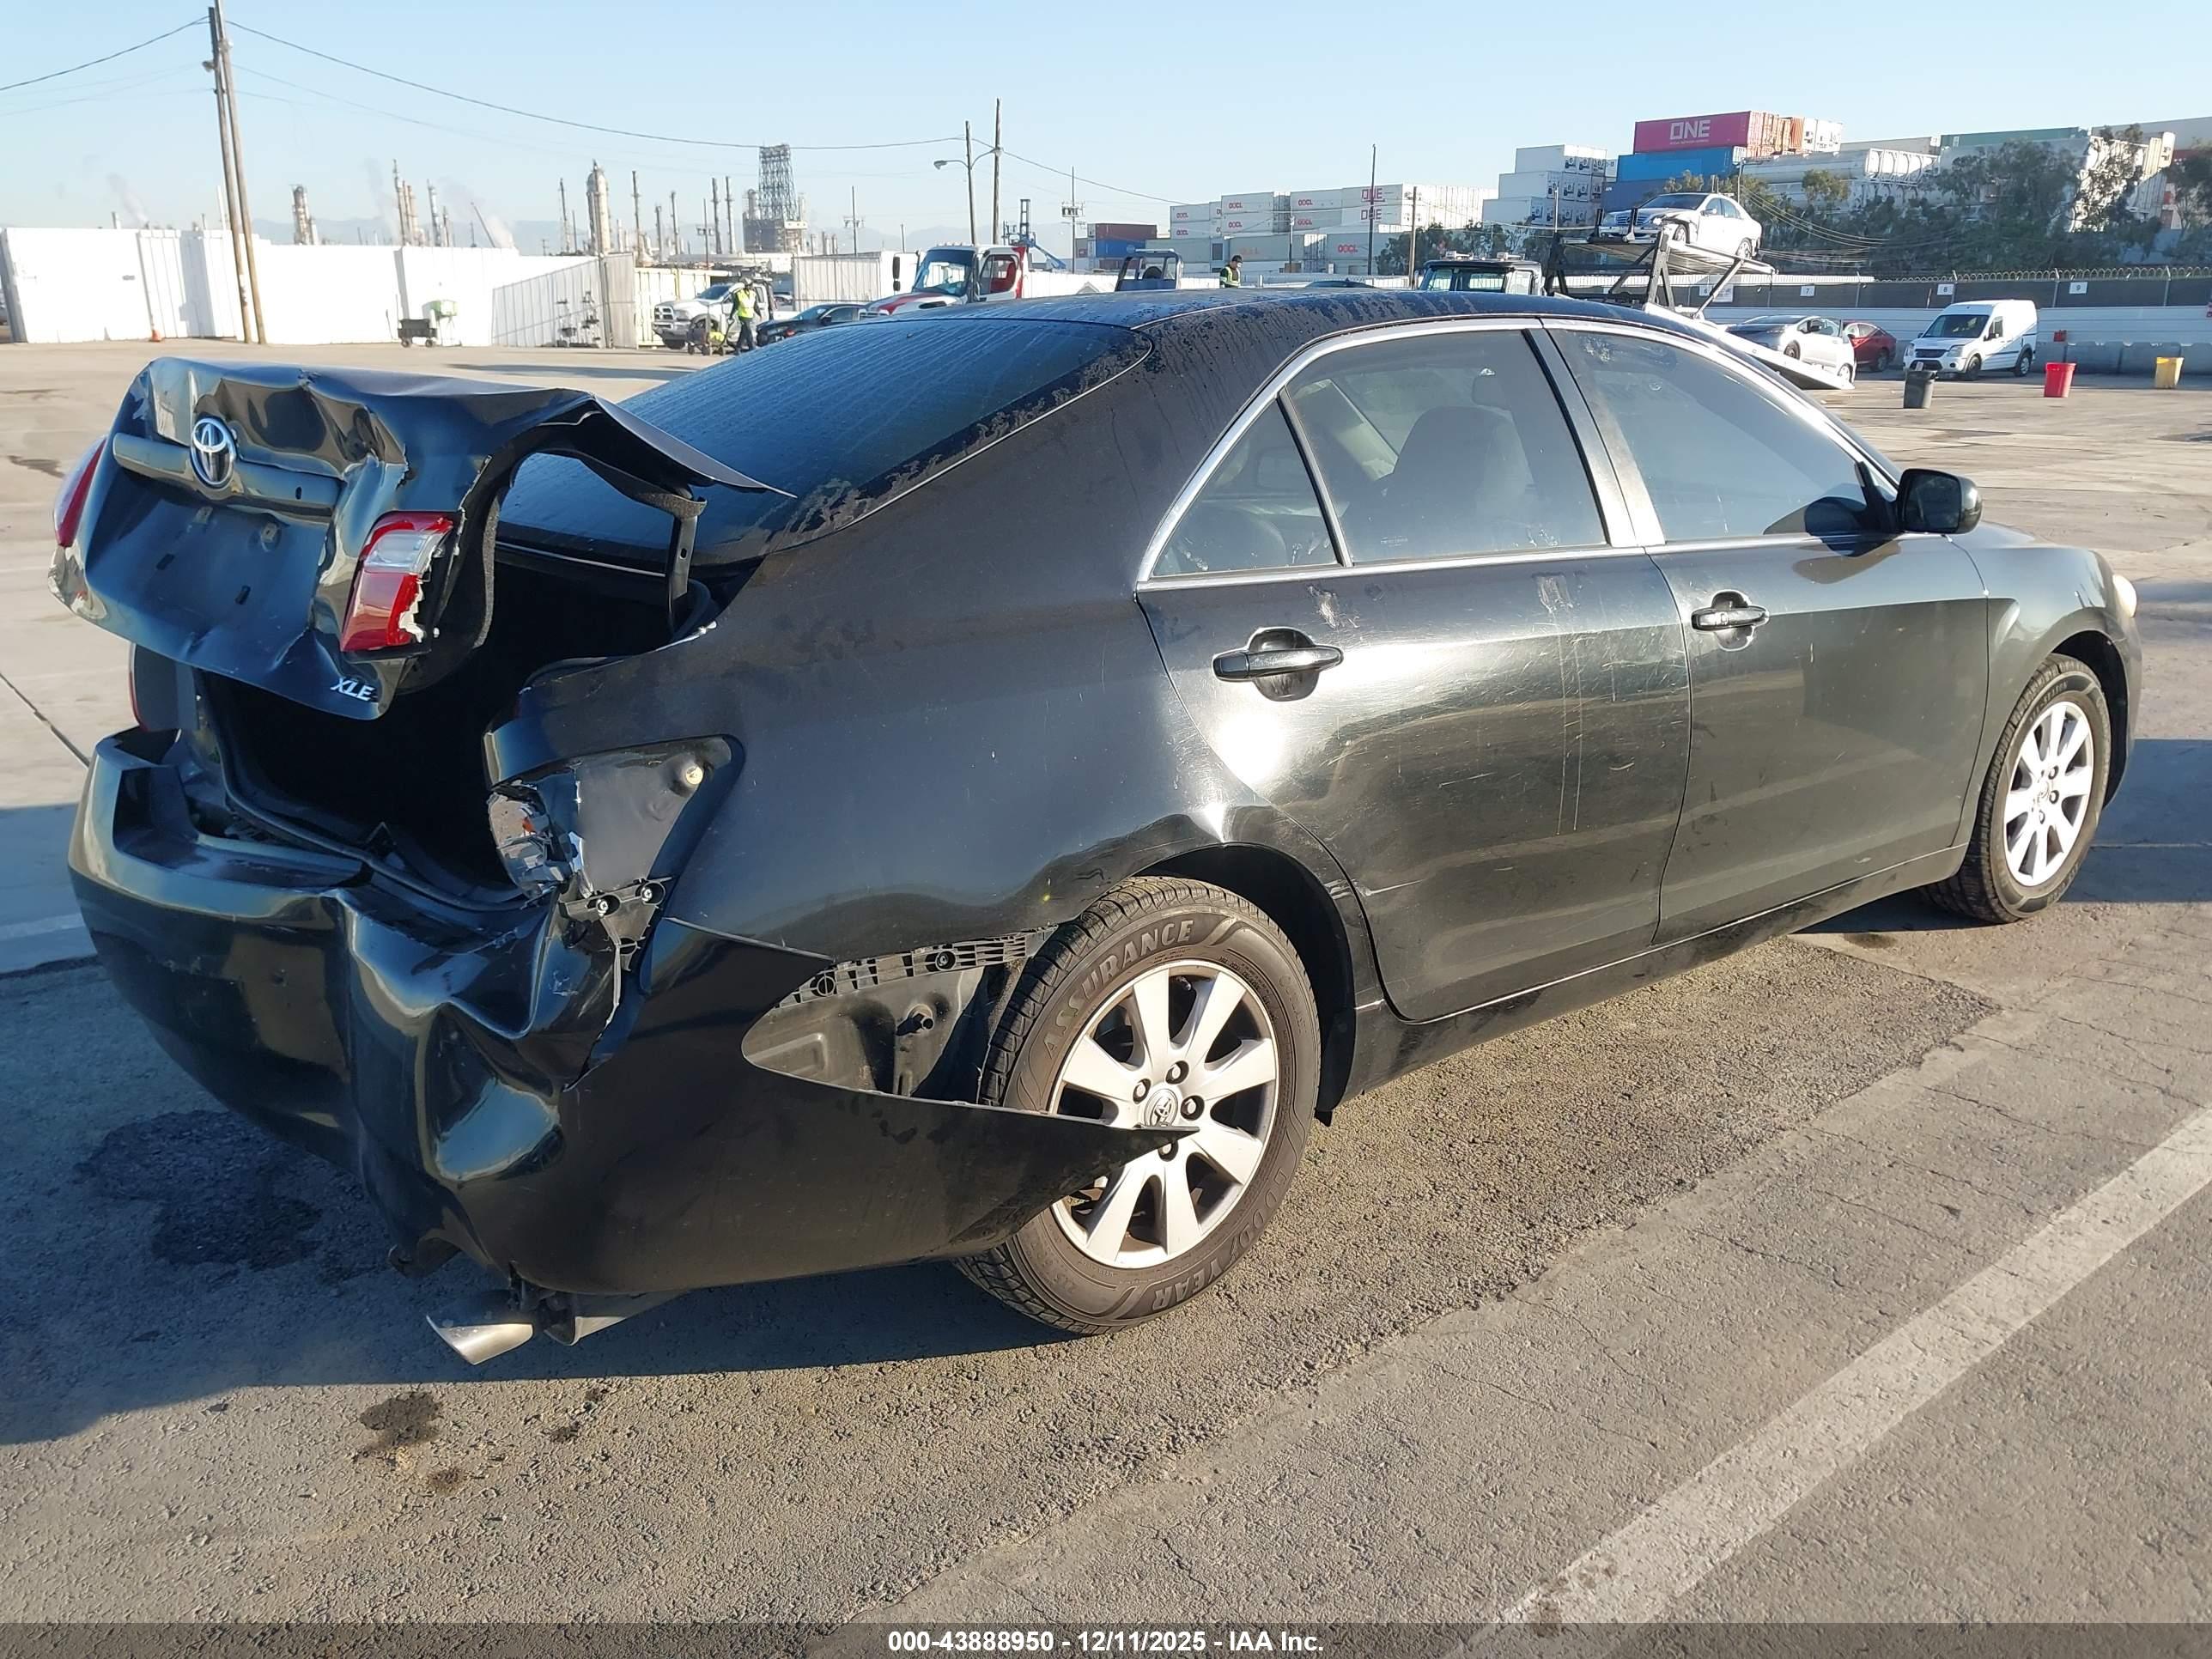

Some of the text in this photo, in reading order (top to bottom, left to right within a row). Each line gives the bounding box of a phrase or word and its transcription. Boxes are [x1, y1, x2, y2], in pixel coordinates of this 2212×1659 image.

[1669, 119, 1711, 140] ONE
[1337, 244, 1358, 253] OOCL
[331, 678, 375, 702] XLE
[1042, 919, 1194, 1060] ASSURANCE
